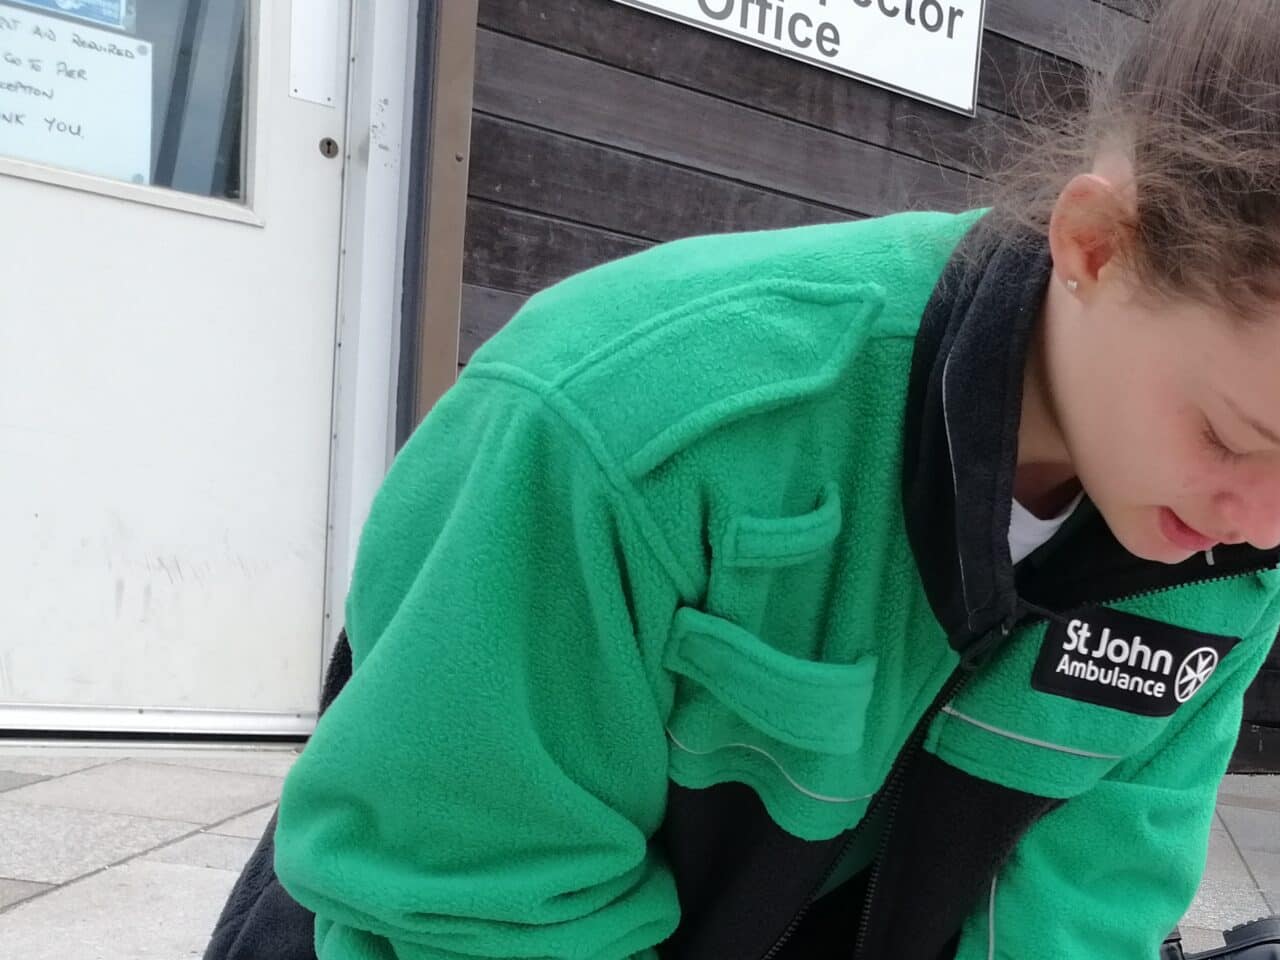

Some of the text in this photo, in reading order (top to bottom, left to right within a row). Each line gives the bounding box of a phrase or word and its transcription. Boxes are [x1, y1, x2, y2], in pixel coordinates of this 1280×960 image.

[72, 32, 135, 59] REQUIRED
[697, 0, 841, 57] Office
[1062, 619, 1173, 676] St John
[1056, 653, 1166, 698] Ambulance
